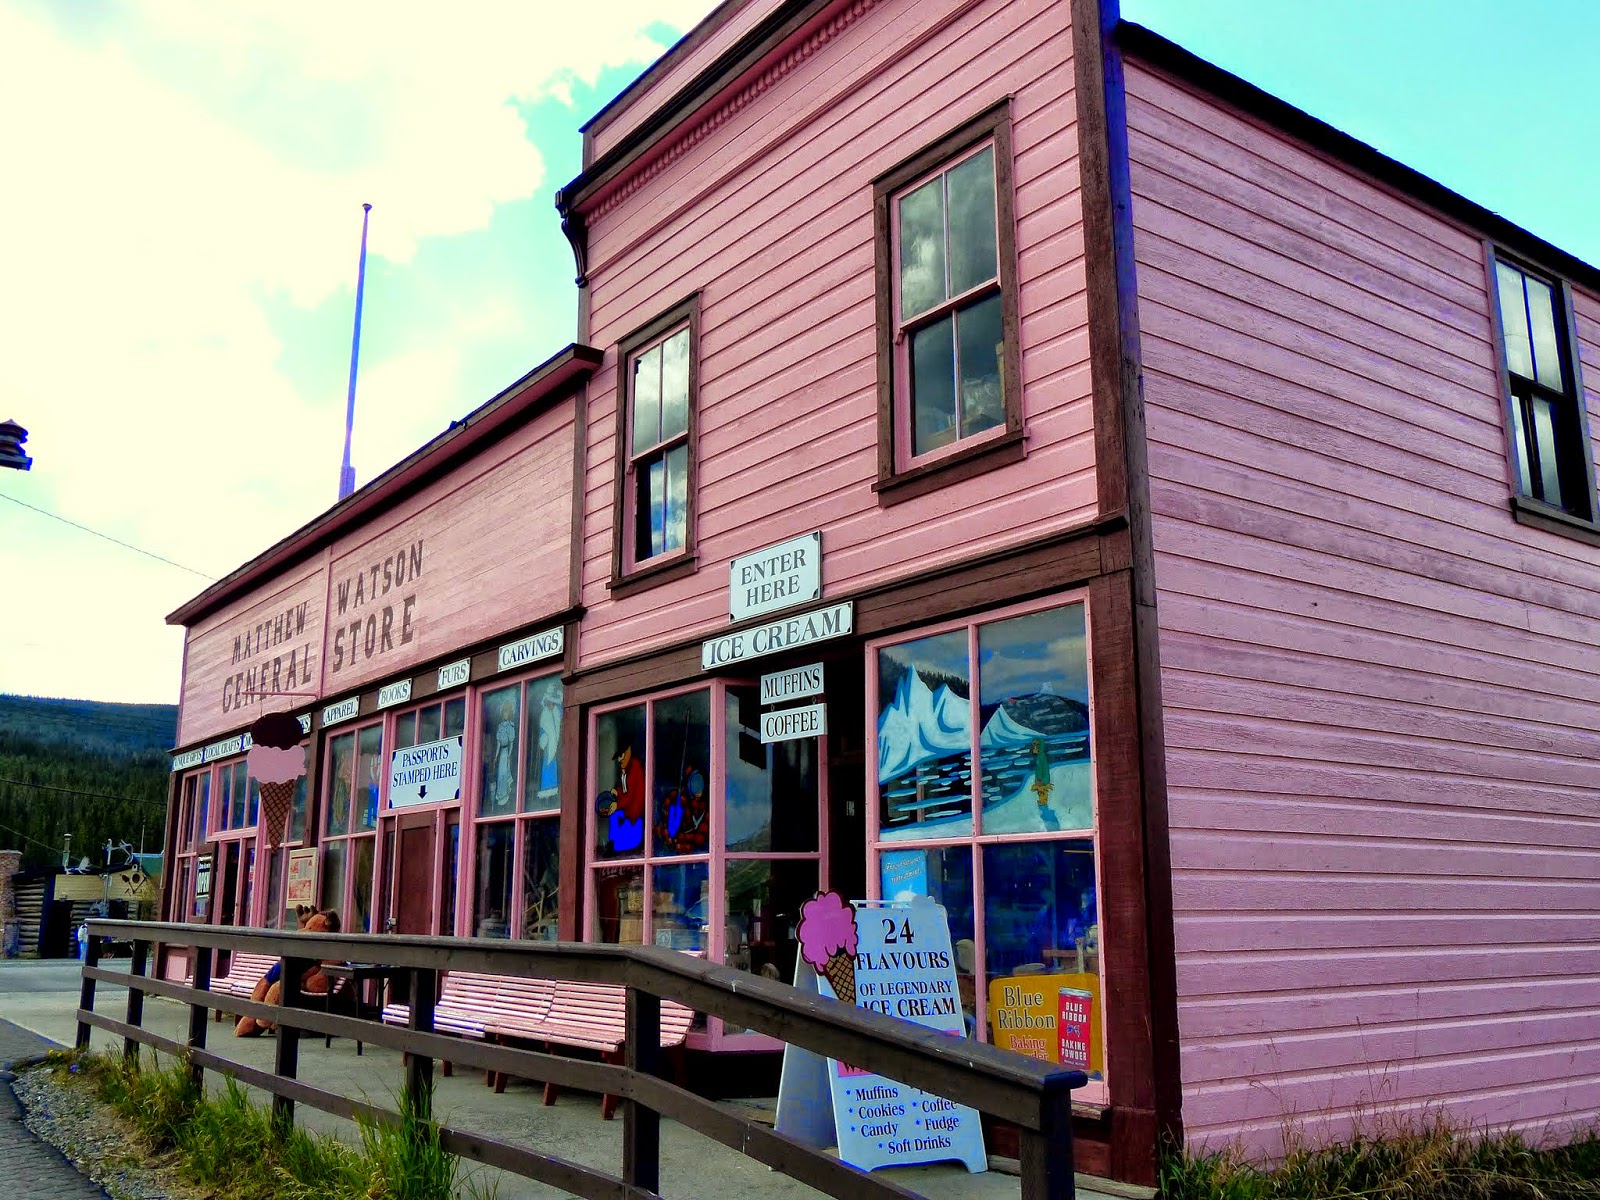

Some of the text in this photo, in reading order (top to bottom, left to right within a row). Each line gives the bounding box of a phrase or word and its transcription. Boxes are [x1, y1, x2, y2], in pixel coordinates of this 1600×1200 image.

[741, 548, 806, 586] ENTER
[746, 574, 800, 607] HERE
[231, 540, 424, 666] MATTHEW WATSON
[709, 608, 841, 665] ICE CREAM
[221, 594, 416, 714] GENERAL STORE
[502, 633, 560, 666] CARVINGS
[441, 664, 467, 686] FURS
[764, 668, 820, 699] MUFFINS
[381, 683, 408, 704] BOOKS
[325, 701, 355, 722] APPAREL
[766, 710, 818, 738] COFFEE
[205, 746, 220, 759] LOCAL
[221, 739, 240, 754] CRAFTS
[402, 744, 449, 767] PASSPORTS
[393, 762, 458, 787] STAMPED HERE
[882, 917, 914, 944] 24
[857, 951, 950, 971] FLAVOURS
[860, 980, 952, 997] OF LEGENDARY
[1004, 985, 1044, 1007] Blue
[897, 997, 957, 1018] CREAM
[1061, 1011, 1087, 1023] RIBBON
[1065, 1001, 1083, 1013] BLUE
[997, 1008, 1056, 1030] Ribbon
[1010, 1033, 1047, 1051] Baking
[1061, 1038, 1086, 1051] BAKING
[1061, 1049, 1087, 1061] POWDER
[855, 1086, 898, 1102] Muffins
[858, 1102, 905, 1120] Cookies
[861, 1115, 960, 1138] Candy Fudge
[888, 1135, 951, 1155] Soft Drinks
